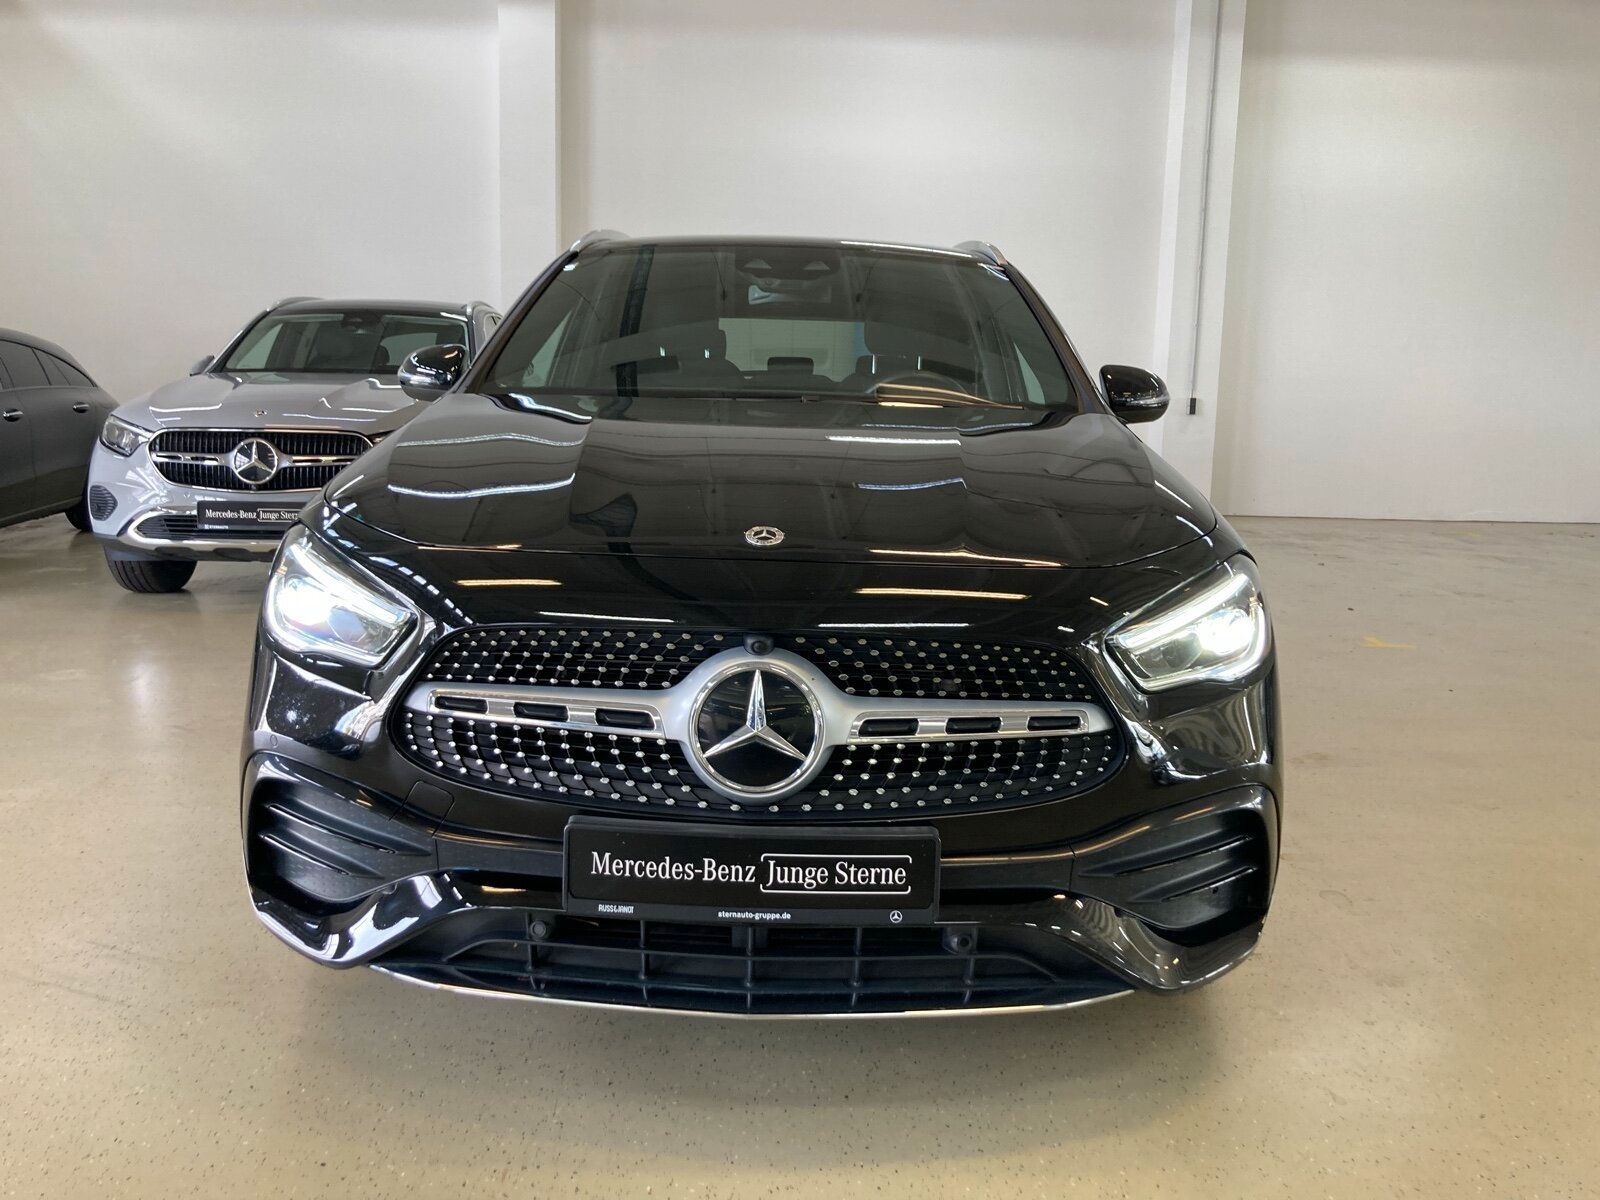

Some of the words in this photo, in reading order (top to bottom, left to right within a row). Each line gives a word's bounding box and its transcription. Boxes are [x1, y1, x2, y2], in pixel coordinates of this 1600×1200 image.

[205, 508, 257, 519] Mercedes-Benz
[259, 510, 280, 520] Junge
[591, 851, 756, 883] Mercedes-Benz
[766, 860, 829, 889] Junge
[834, 861, 907, 885] Sterne
[717, 910, 792, 921] sternauto-gruppe.de
